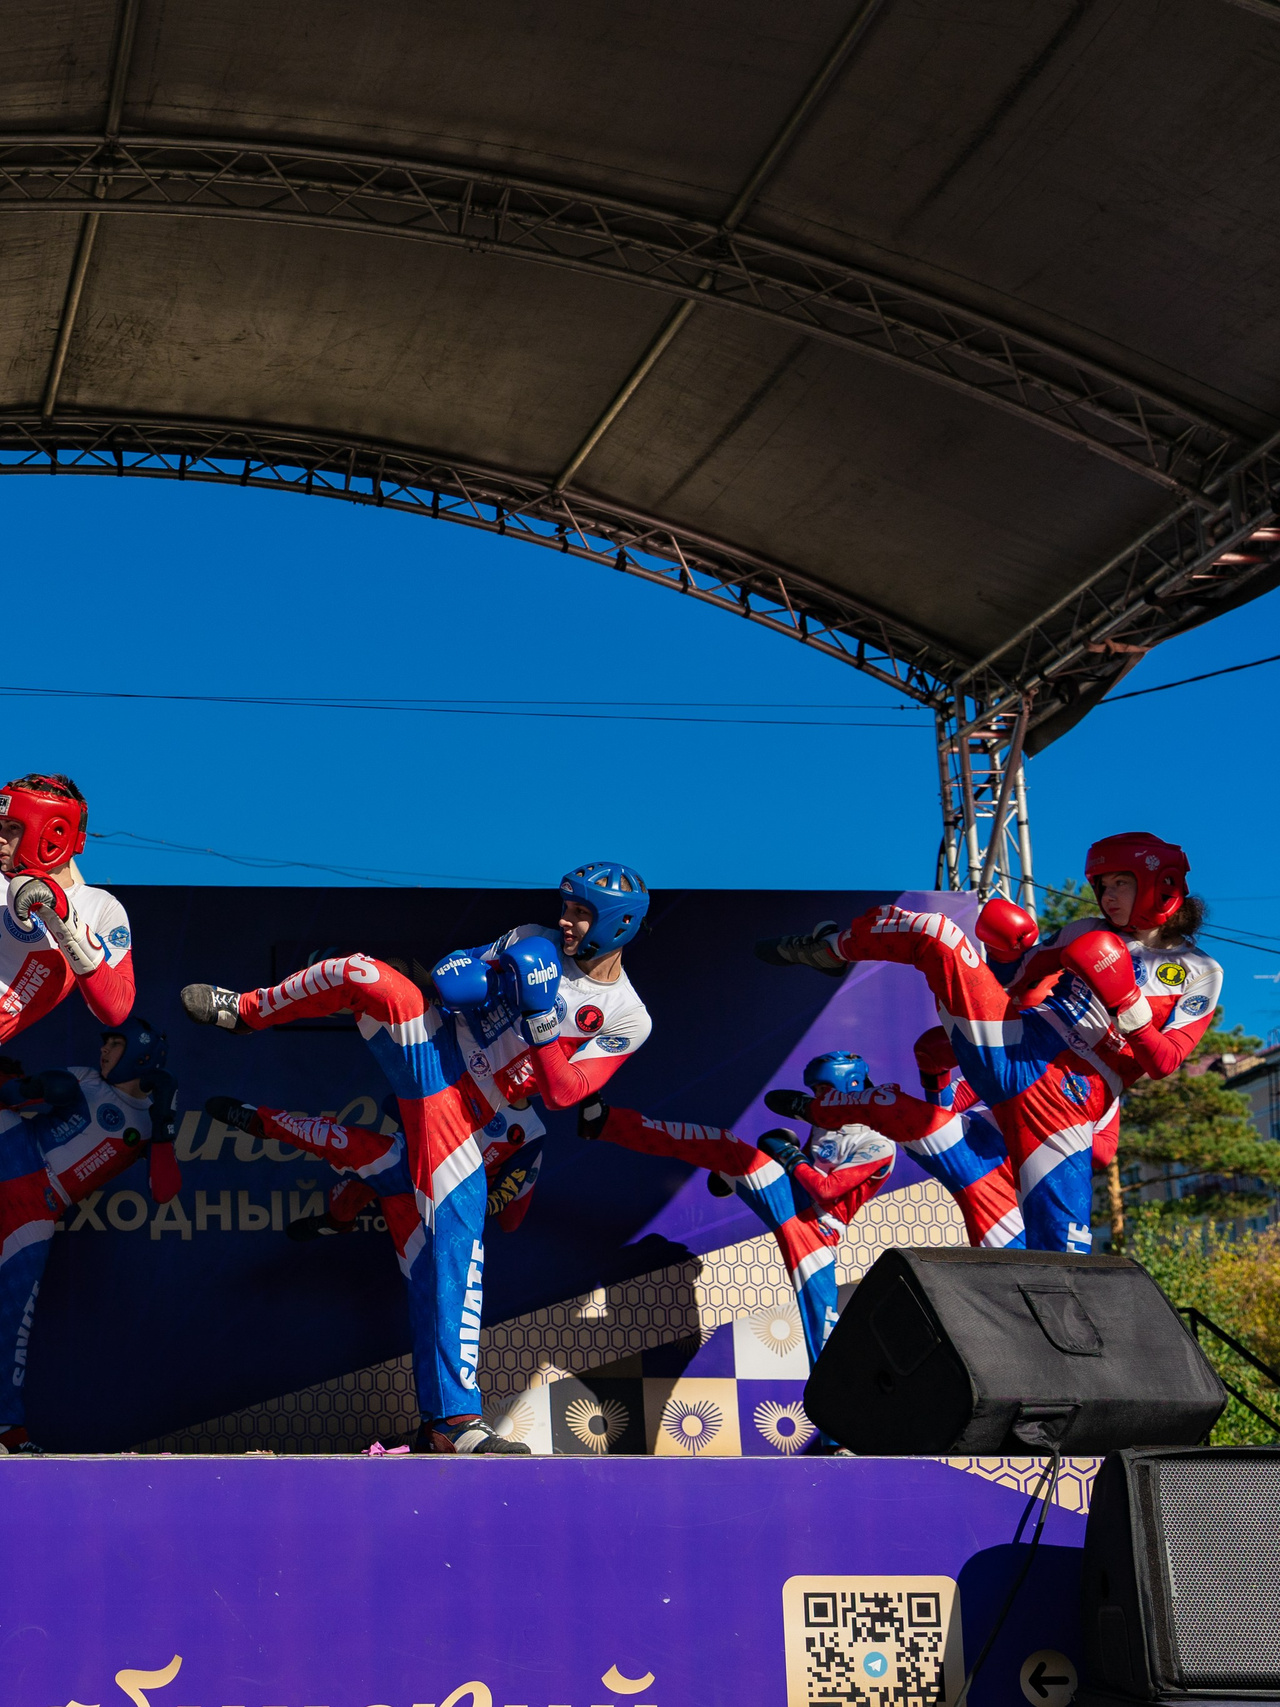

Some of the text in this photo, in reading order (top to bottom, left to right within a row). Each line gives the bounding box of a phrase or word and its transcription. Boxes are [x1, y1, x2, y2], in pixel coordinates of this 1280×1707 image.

[436, 955, 473, 977] clinch
[526, 960, 559, 989] clinch
[1093, 951, 1121, 974] clinch
[258, 952, 381, 1019] SAVATE
[536, 1016, 559, 1034] clinch
[73, 1145, 118, 1182] SAVATE
[459, 1239, 485, 1392] SAVATE
